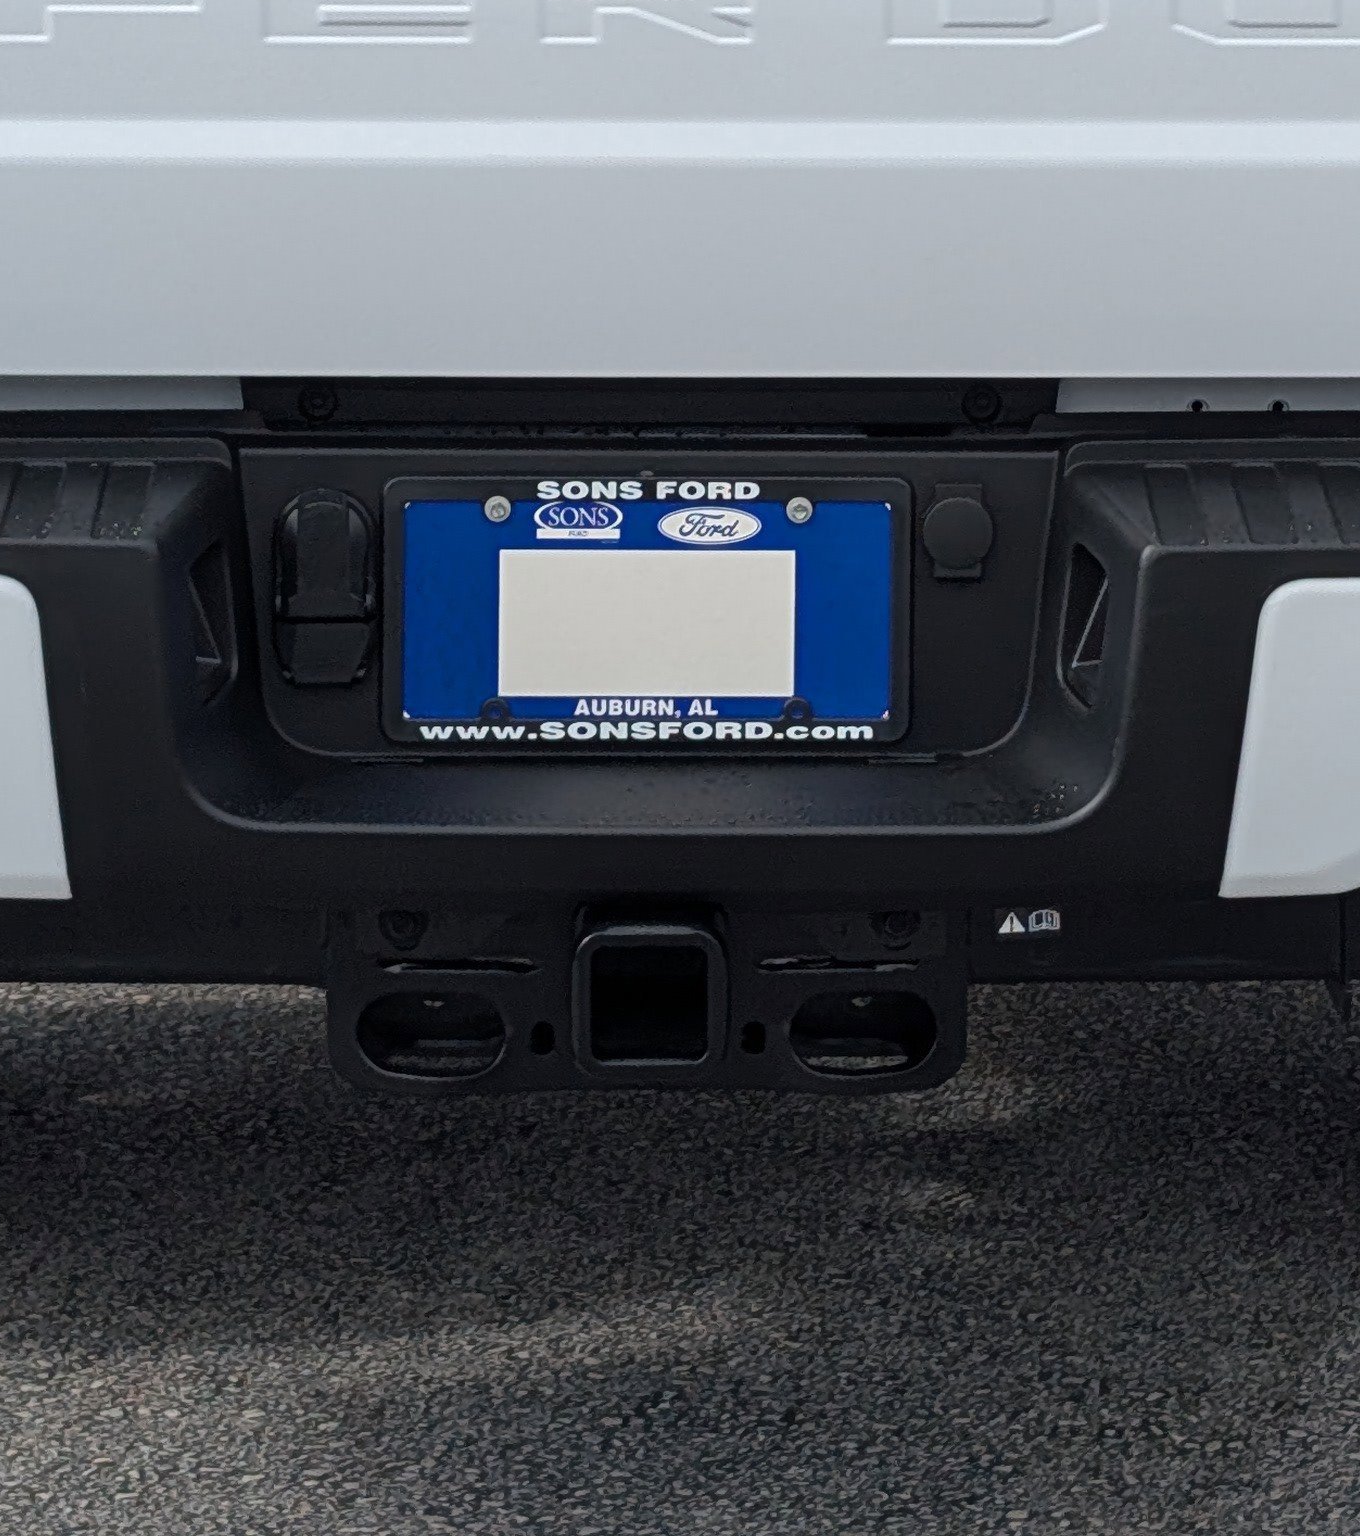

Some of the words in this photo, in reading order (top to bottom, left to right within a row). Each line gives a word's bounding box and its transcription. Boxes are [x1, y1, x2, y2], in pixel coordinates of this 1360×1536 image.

[536, 480, 643, 500] SONS
[656, 481, 761, 500] FORD
[547, 506, 610, 527] SONS
[678, 513, 740, 537] Ford
[574, 699, 682, 719] AUBURN,
[688, 699, 719, 717] AL
[420, 721, 874, 741] www.SONSFORD.com
